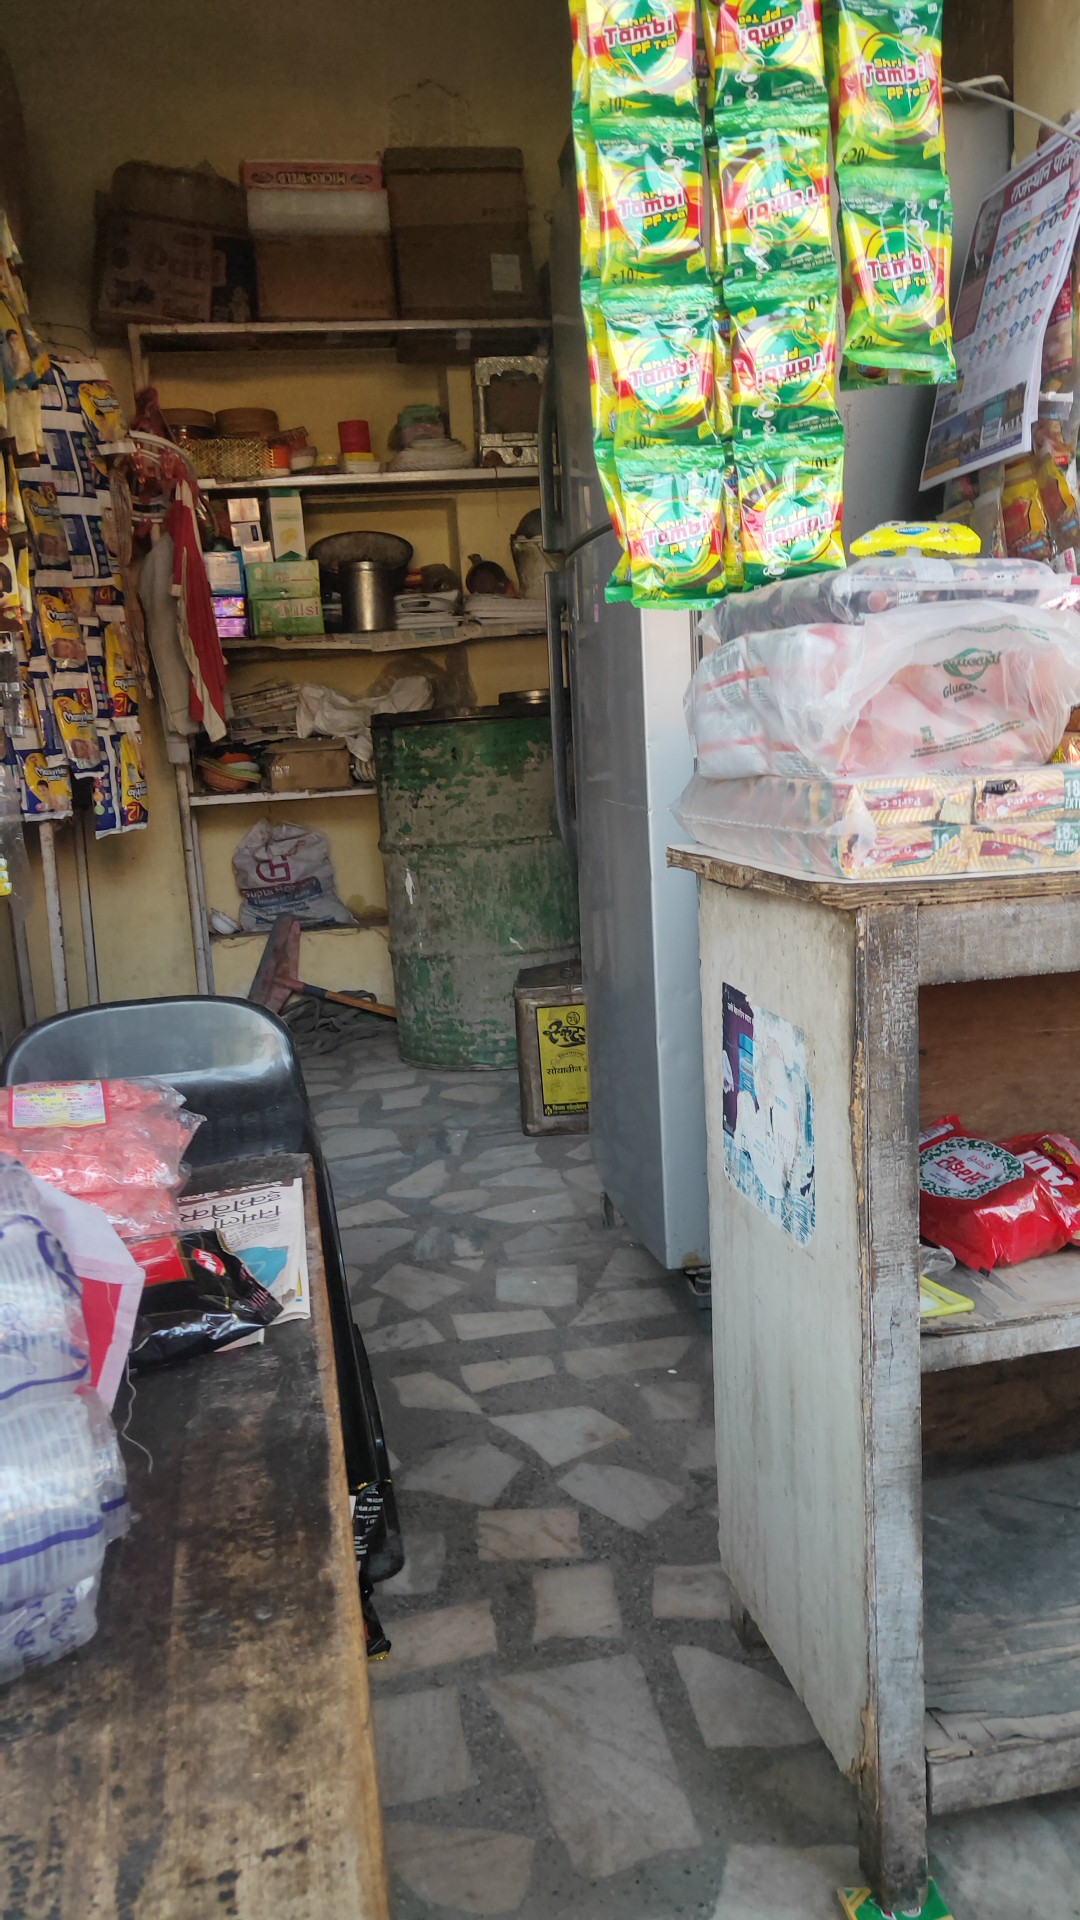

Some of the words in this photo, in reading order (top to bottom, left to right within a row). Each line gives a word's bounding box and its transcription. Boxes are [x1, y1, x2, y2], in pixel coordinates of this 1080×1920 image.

[603, 17, 674, 47] Tambi
[740, 10, 809, 50] Tambi
[862, 56, 926, 86] Tambi
[618, 189, 684, 218] Tambi
[867, 251, 929, 280] Tambi
[629, 356, 696, 388] Tambi
[642, 515, 710, 547] Tambi
[275, 601, 320, 618] Tulsi
